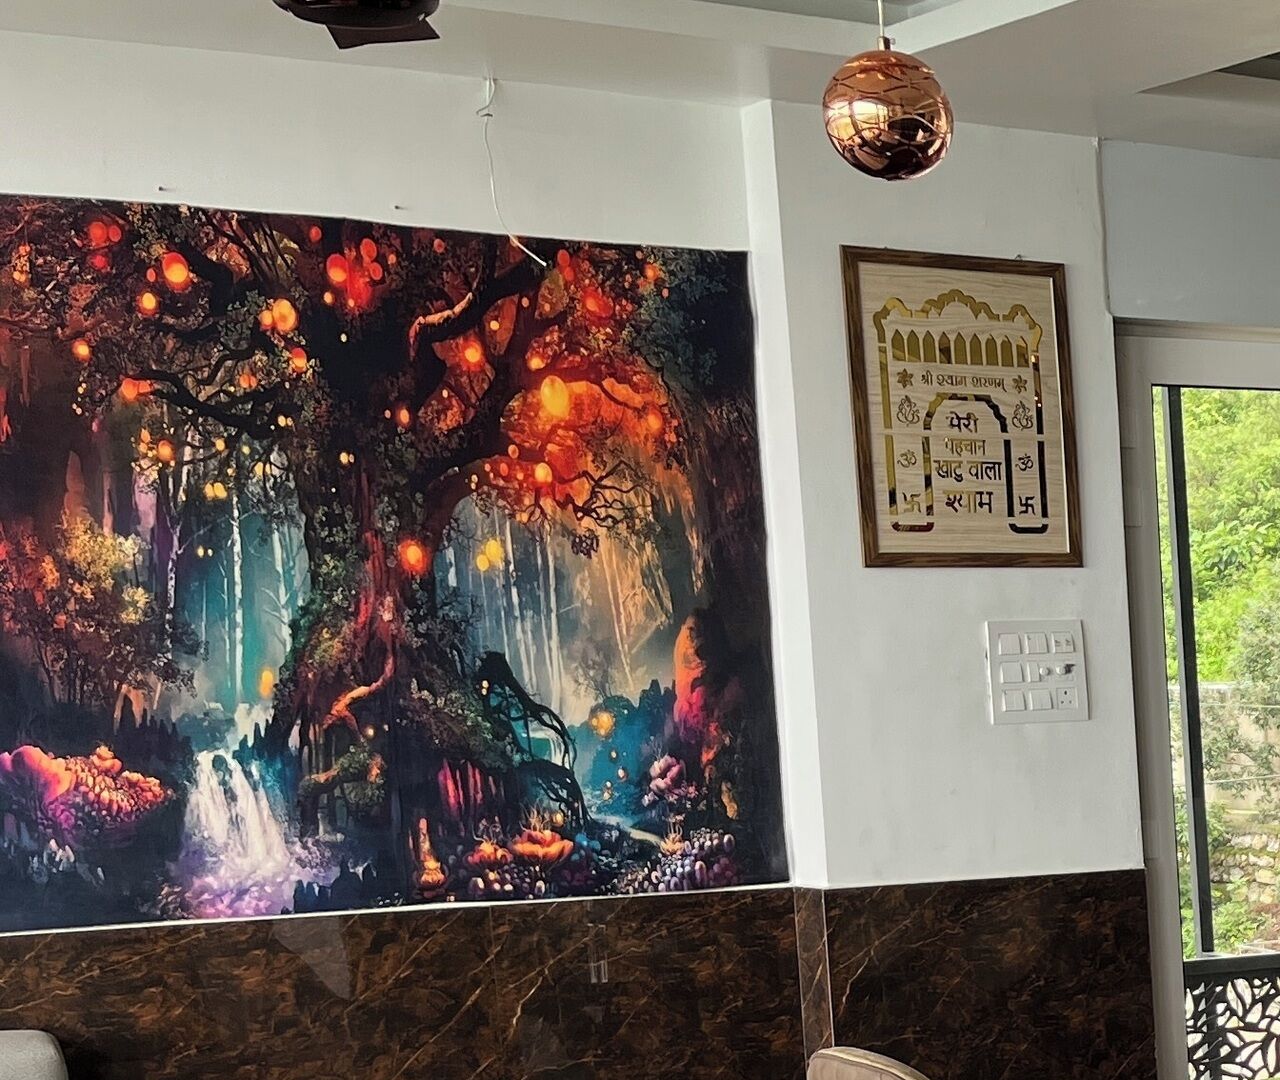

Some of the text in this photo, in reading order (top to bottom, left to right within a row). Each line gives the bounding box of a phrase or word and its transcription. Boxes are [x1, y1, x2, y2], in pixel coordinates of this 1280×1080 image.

[921, 370, 1008, 392] श्री श्याम शरणम्
[944, 438, 986, 457] पहचान
[967, 461, 1002, 481] वाला
[943, 490, 994, 514] श्याम
